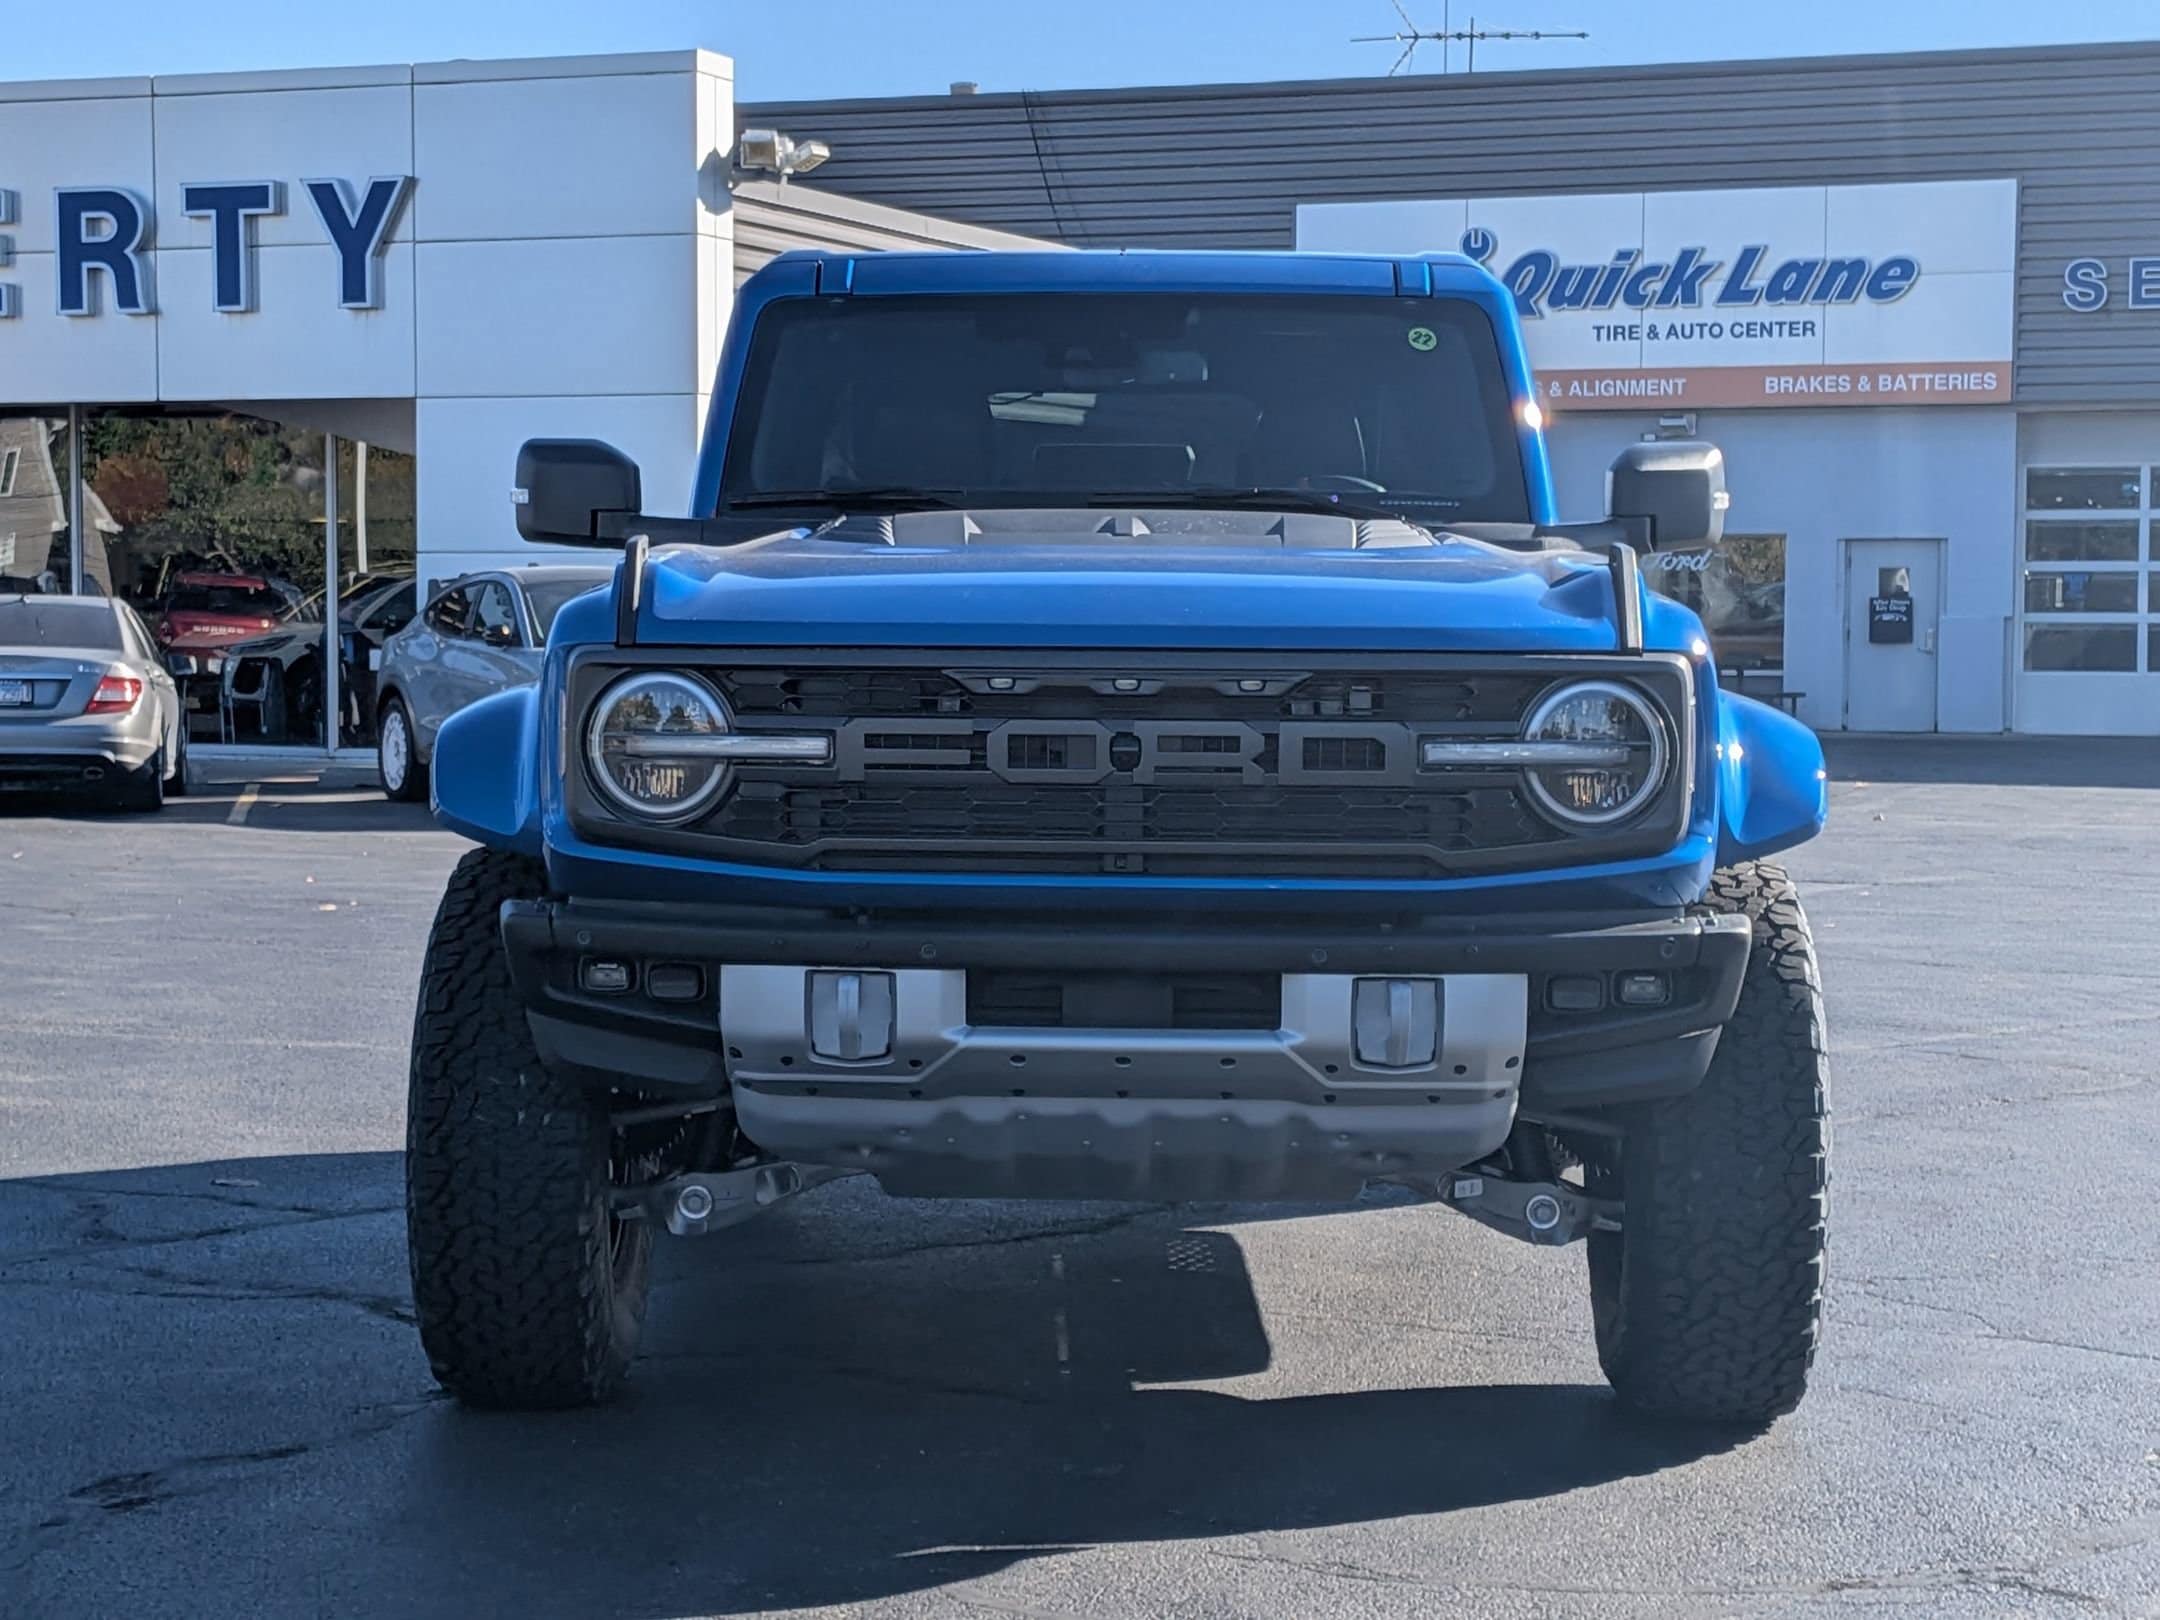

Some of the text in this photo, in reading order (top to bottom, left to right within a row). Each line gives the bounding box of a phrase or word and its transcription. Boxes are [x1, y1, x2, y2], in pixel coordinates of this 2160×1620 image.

[0, 175, 415, 317] RTY
[1501, 243, 1920, 318] Quick Lane
[1411, 330, 1433, 348] 22
[1592, 320, 1816, 342] TIRE & AUTO CENTER
[1549, 381, 1563, 397] &
[1568, 378, 1687, 397] ALIGNMENT
[1764, 371, 1998, 394] BRAKES & BATTERIES
[837, 717, 1417, 786] FORD
